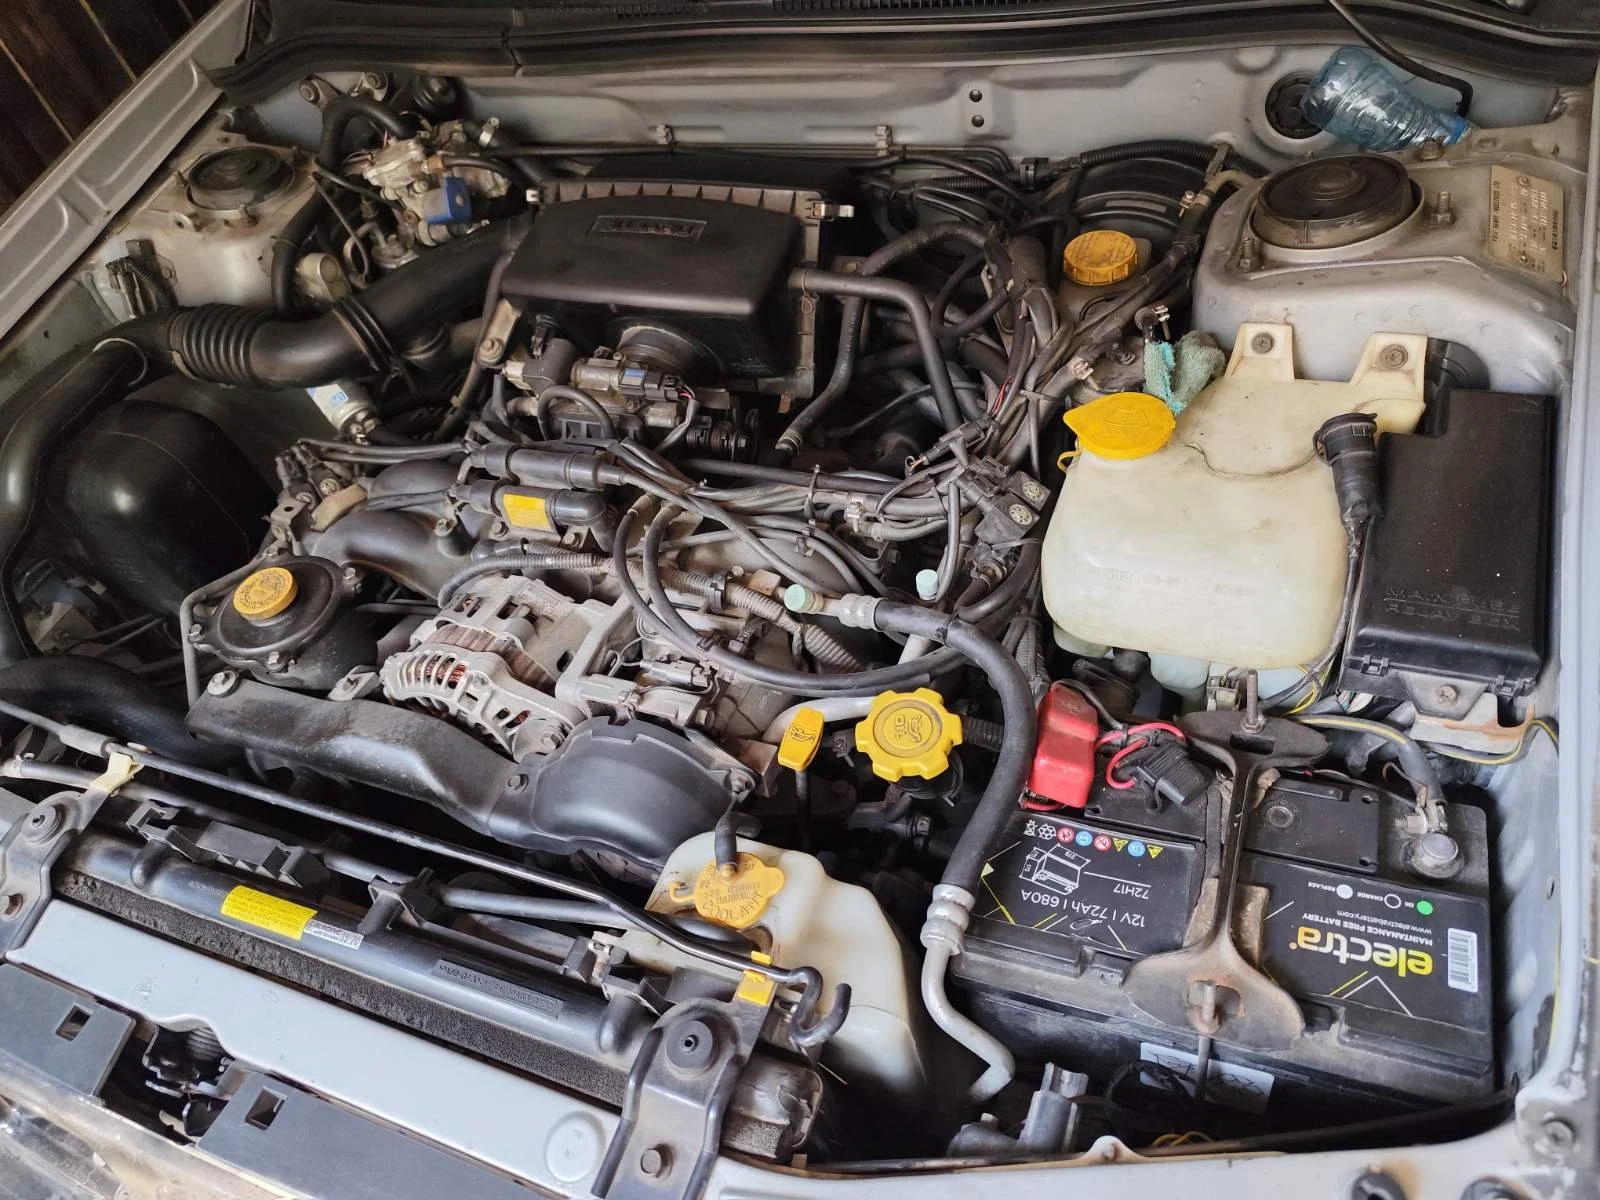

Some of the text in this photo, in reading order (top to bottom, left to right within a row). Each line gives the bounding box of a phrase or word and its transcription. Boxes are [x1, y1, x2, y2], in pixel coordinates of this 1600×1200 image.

[895, 714, 907, 741] OIL
[1021, 889, 1060, 908] 680A
[1113, 883, 1150, 900] 72H17
[1357, 891, 1384, 902] CHARGE
[1071, 899, 1108, 920] 72Ah
[1120, 912, 1145, 928] 12V
[1302, 912, 1341, 927] BATTERY
[1336, 910, 1432, 935] www.electrabattery.com
[1342, 920, 1366, 933] FREE
[1297, 926, 1433, 978] electra
